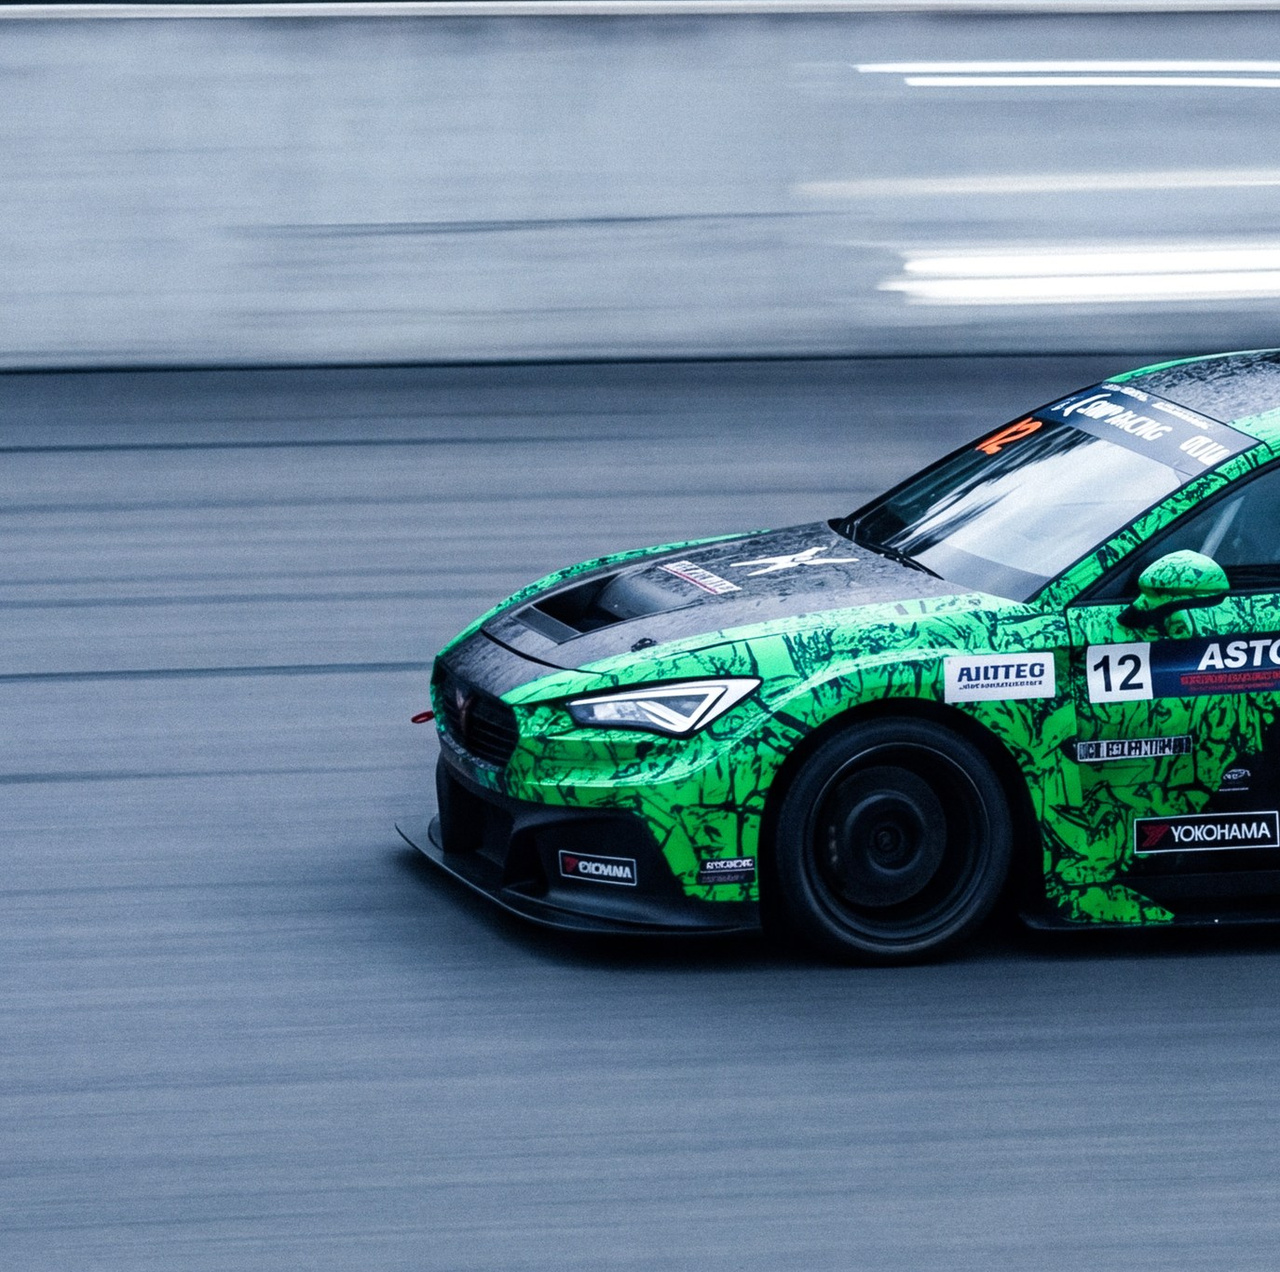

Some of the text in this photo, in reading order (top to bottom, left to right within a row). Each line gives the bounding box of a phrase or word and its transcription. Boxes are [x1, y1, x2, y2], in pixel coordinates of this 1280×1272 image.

[975, 417, 1042, 455] 12
[1093, 654, 1144, 693] 12
[1171, 822, 1271, 843] YOKOHAMA
